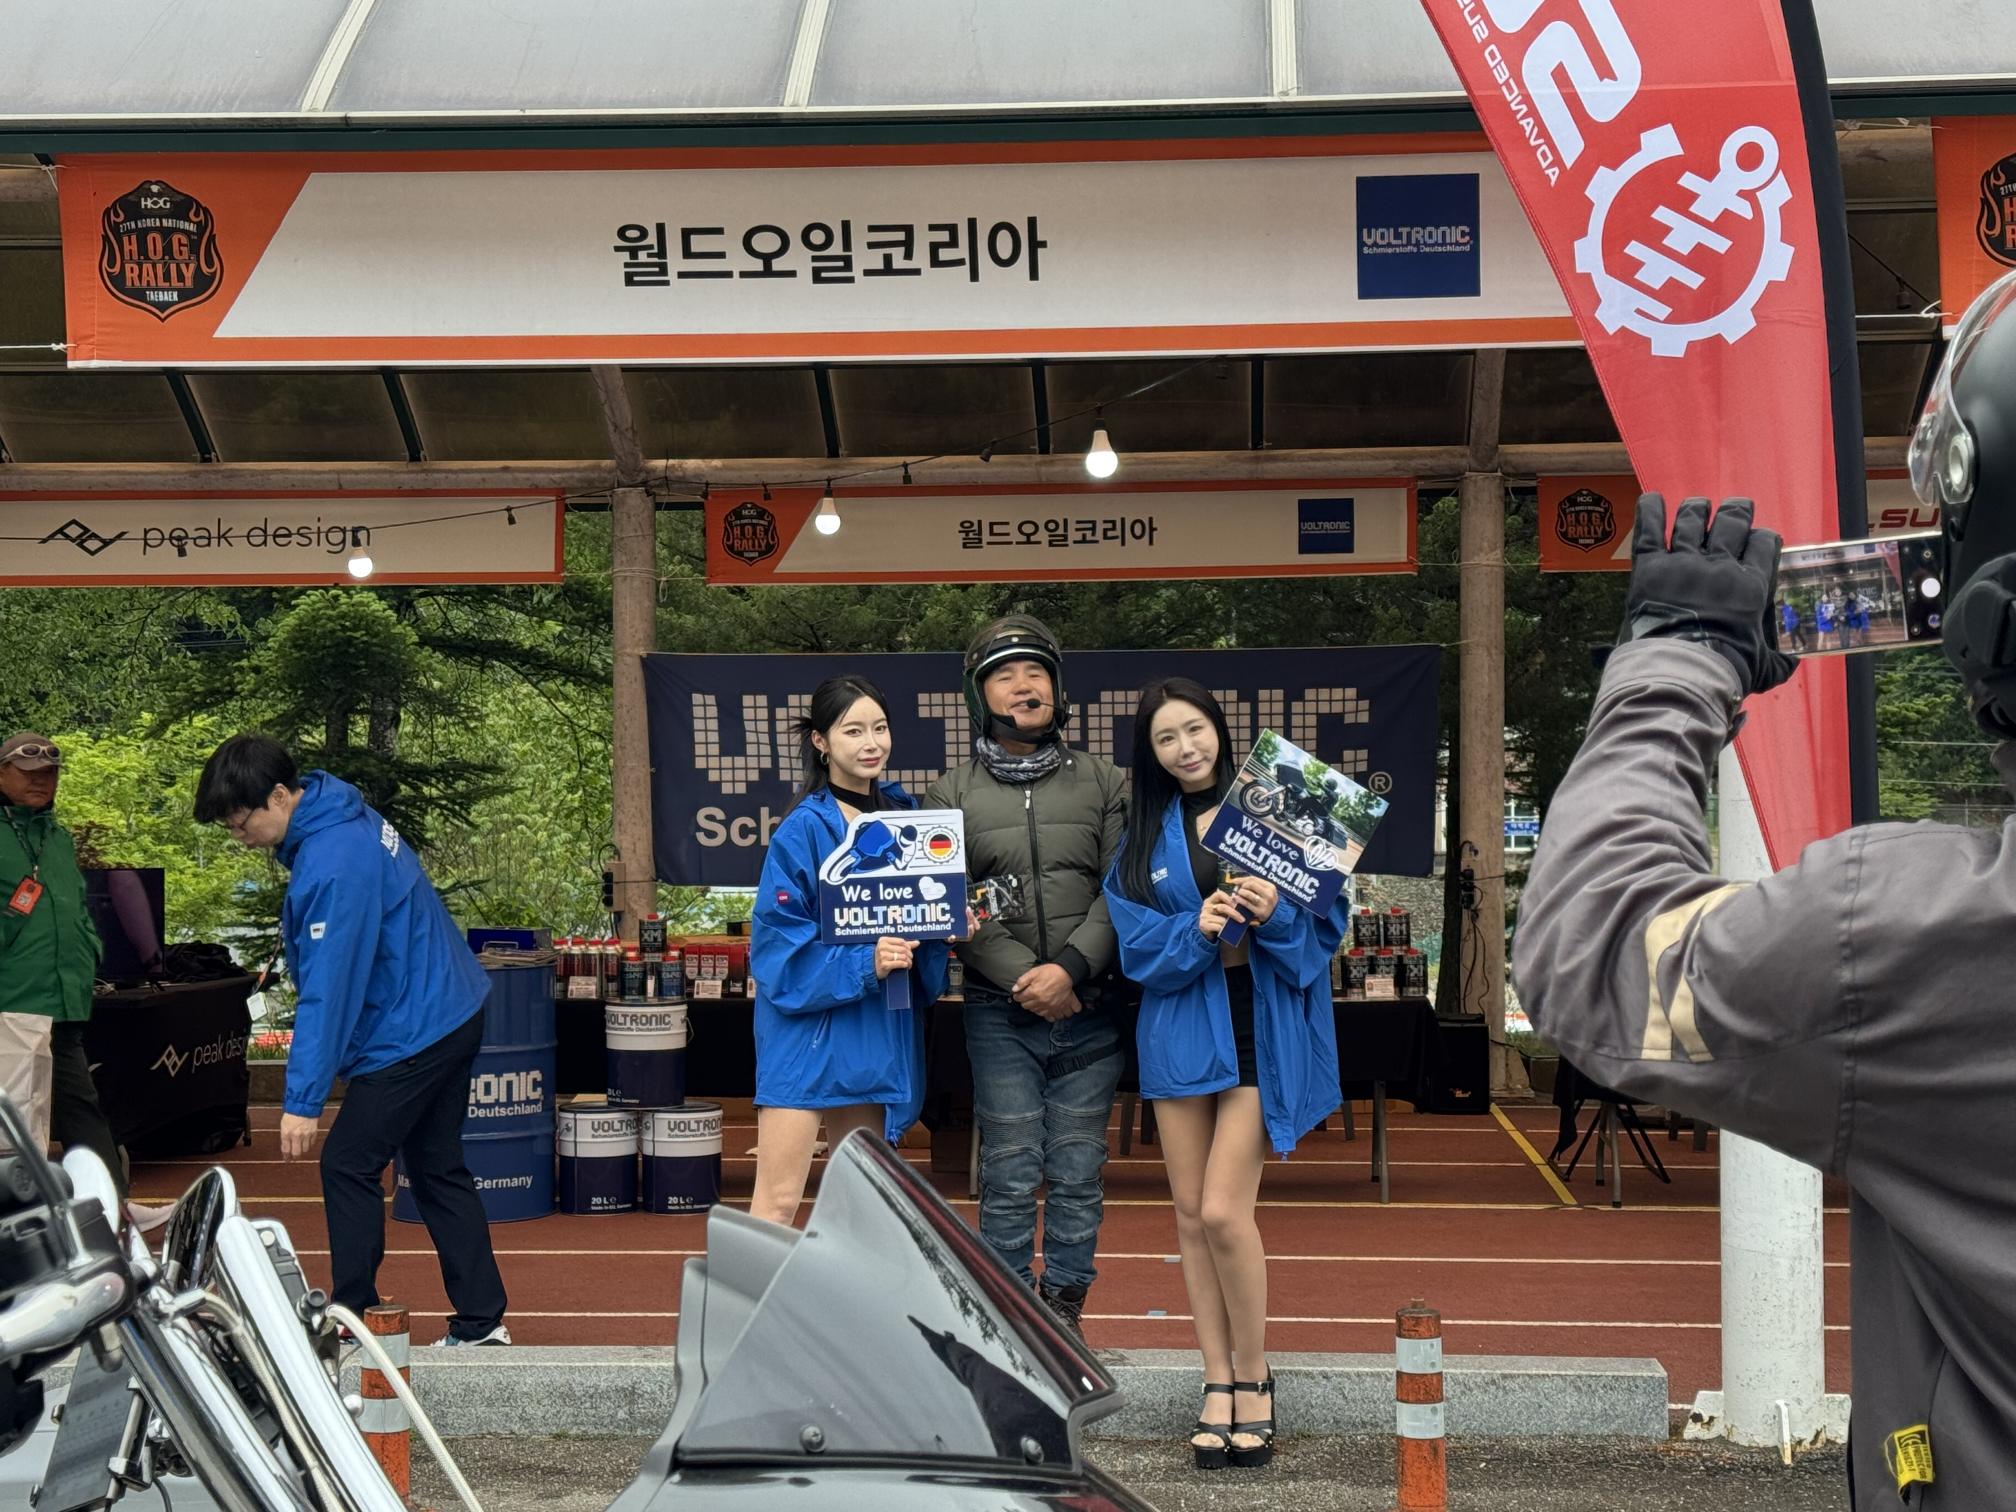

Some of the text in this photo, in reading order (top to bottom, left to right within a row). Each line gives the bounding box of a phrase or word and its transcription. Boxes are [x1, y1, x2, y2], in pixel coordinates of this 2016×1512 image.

[141, 197, 171, 209] HOG
[162, 218, 197, 232] NATIONAL
[613, 216, 1048, 287] 월드오일코리아
[124, 262, 196, 288] RALLY
[143, 517, 371, 555] peak design
[734, 539, 767, 551] RALLY
[957, 516, 1158, 550] 월드오일코리아
[1241, 815, 1300, 861] We love
[1224, 827, 1320, 895] VOLTRONIC
[842, 883, 913, 902] We love
[834, 902, 952, 928] VOLTRONIC
[835, 922, 951, 937] Schmierstoffe Deutschland
[192, 1033, 224, 1074] peak
[468, 1101, 543, 1119] Deutschland
[473, 1175, 534, 1190] Germany
